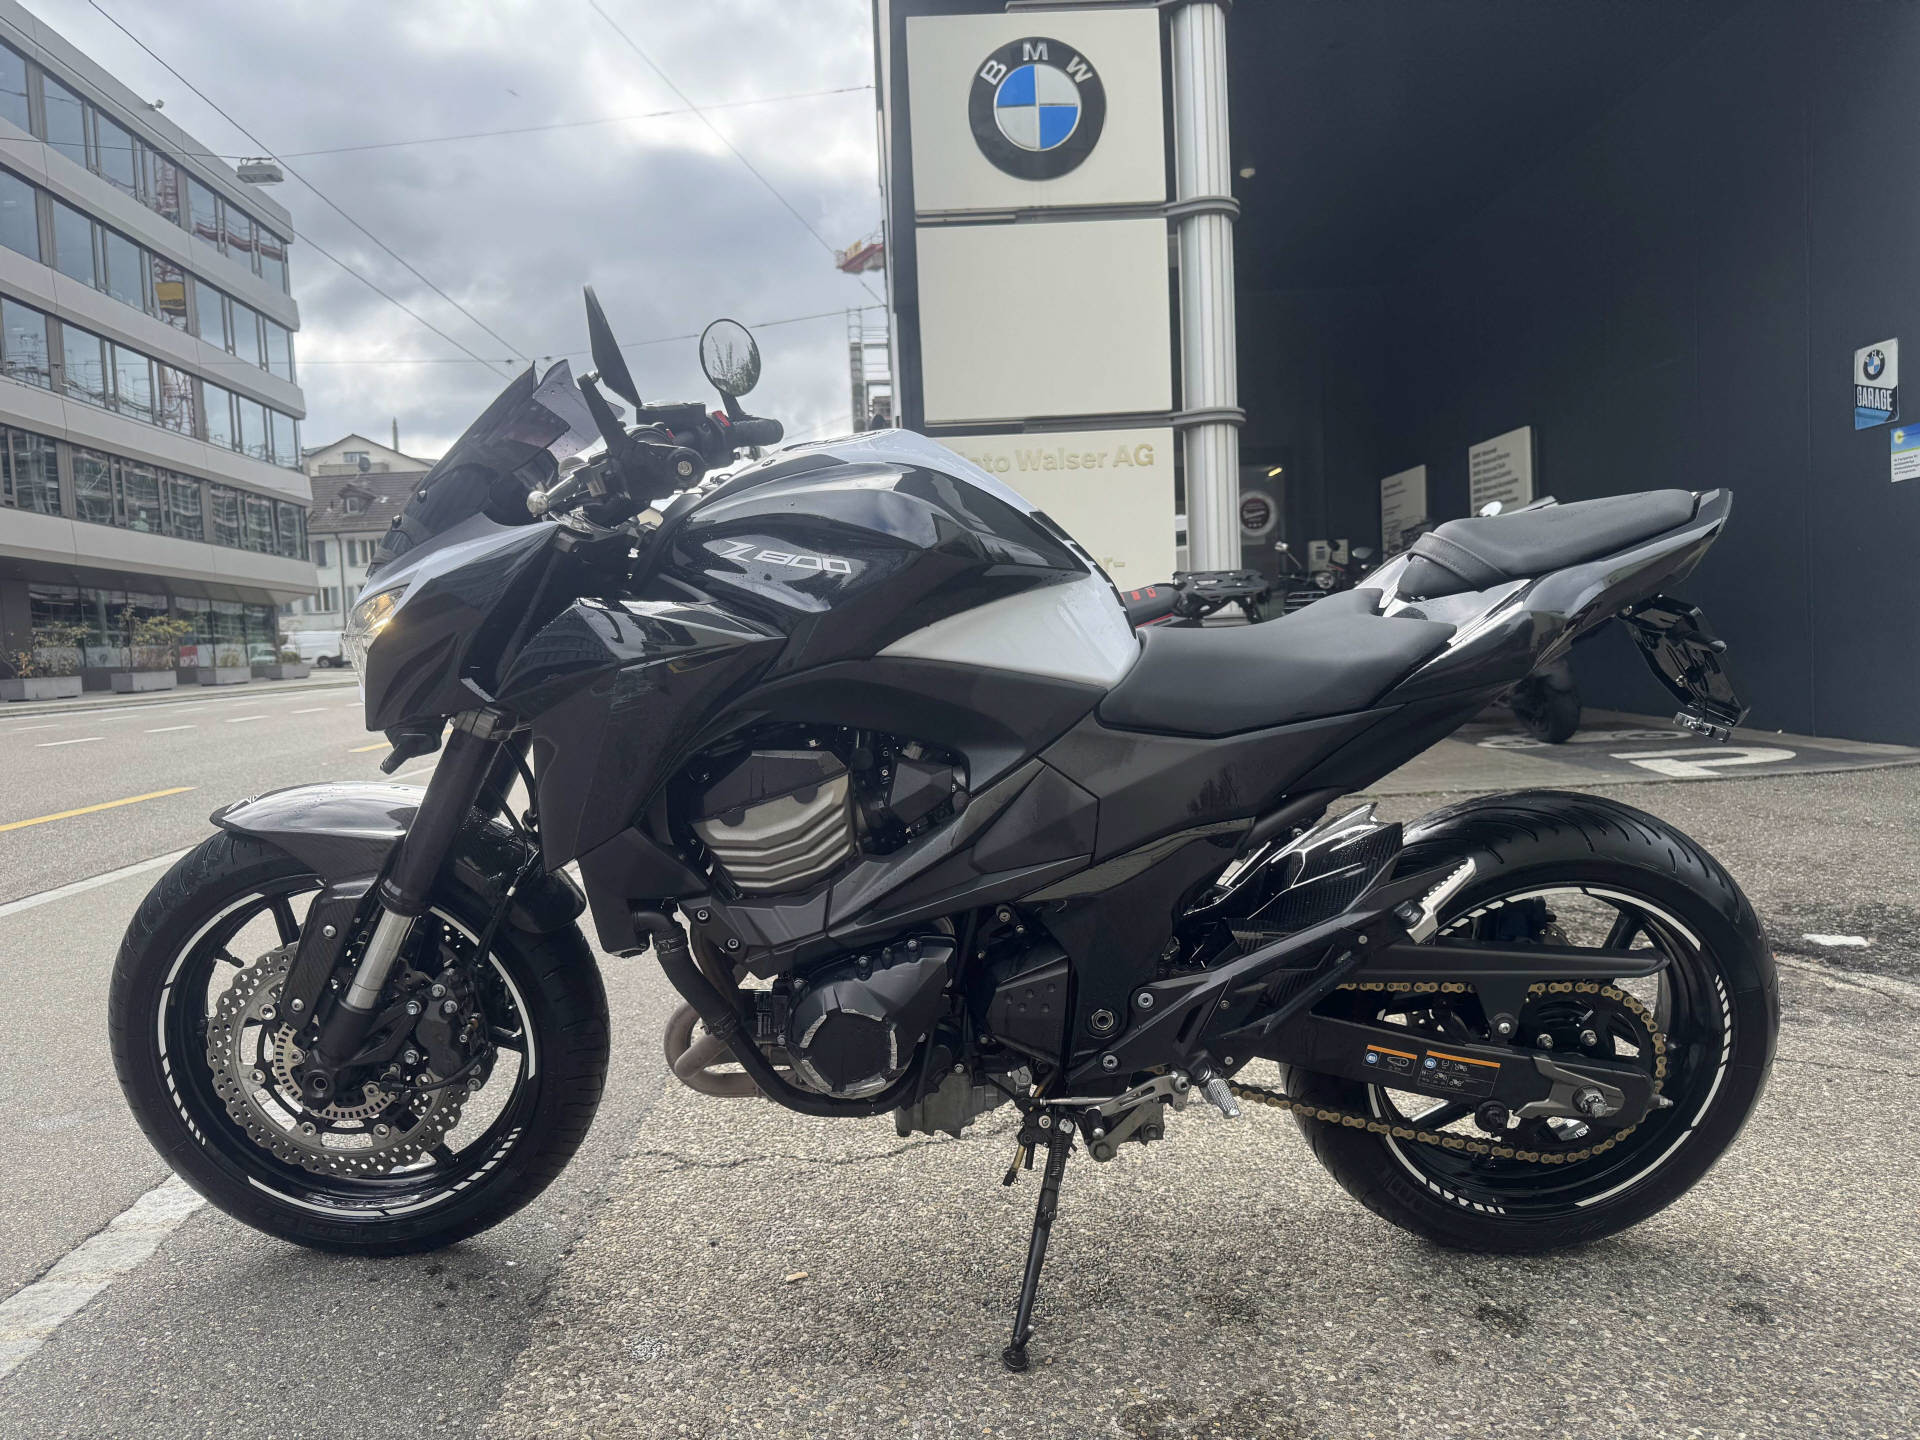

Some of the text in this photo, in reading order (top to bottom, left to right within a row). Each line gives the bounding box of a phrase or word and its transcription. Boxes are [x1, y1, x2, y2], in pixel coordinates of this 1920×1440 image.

[979, 39, 1094, 86] BMW
[1856, 386, 1893, 411] GARAGE
[1015, 447, 1107, 472] Walser
[1111, 443, 1155, 468] AG
[717, 539, 852, 574] Z800
